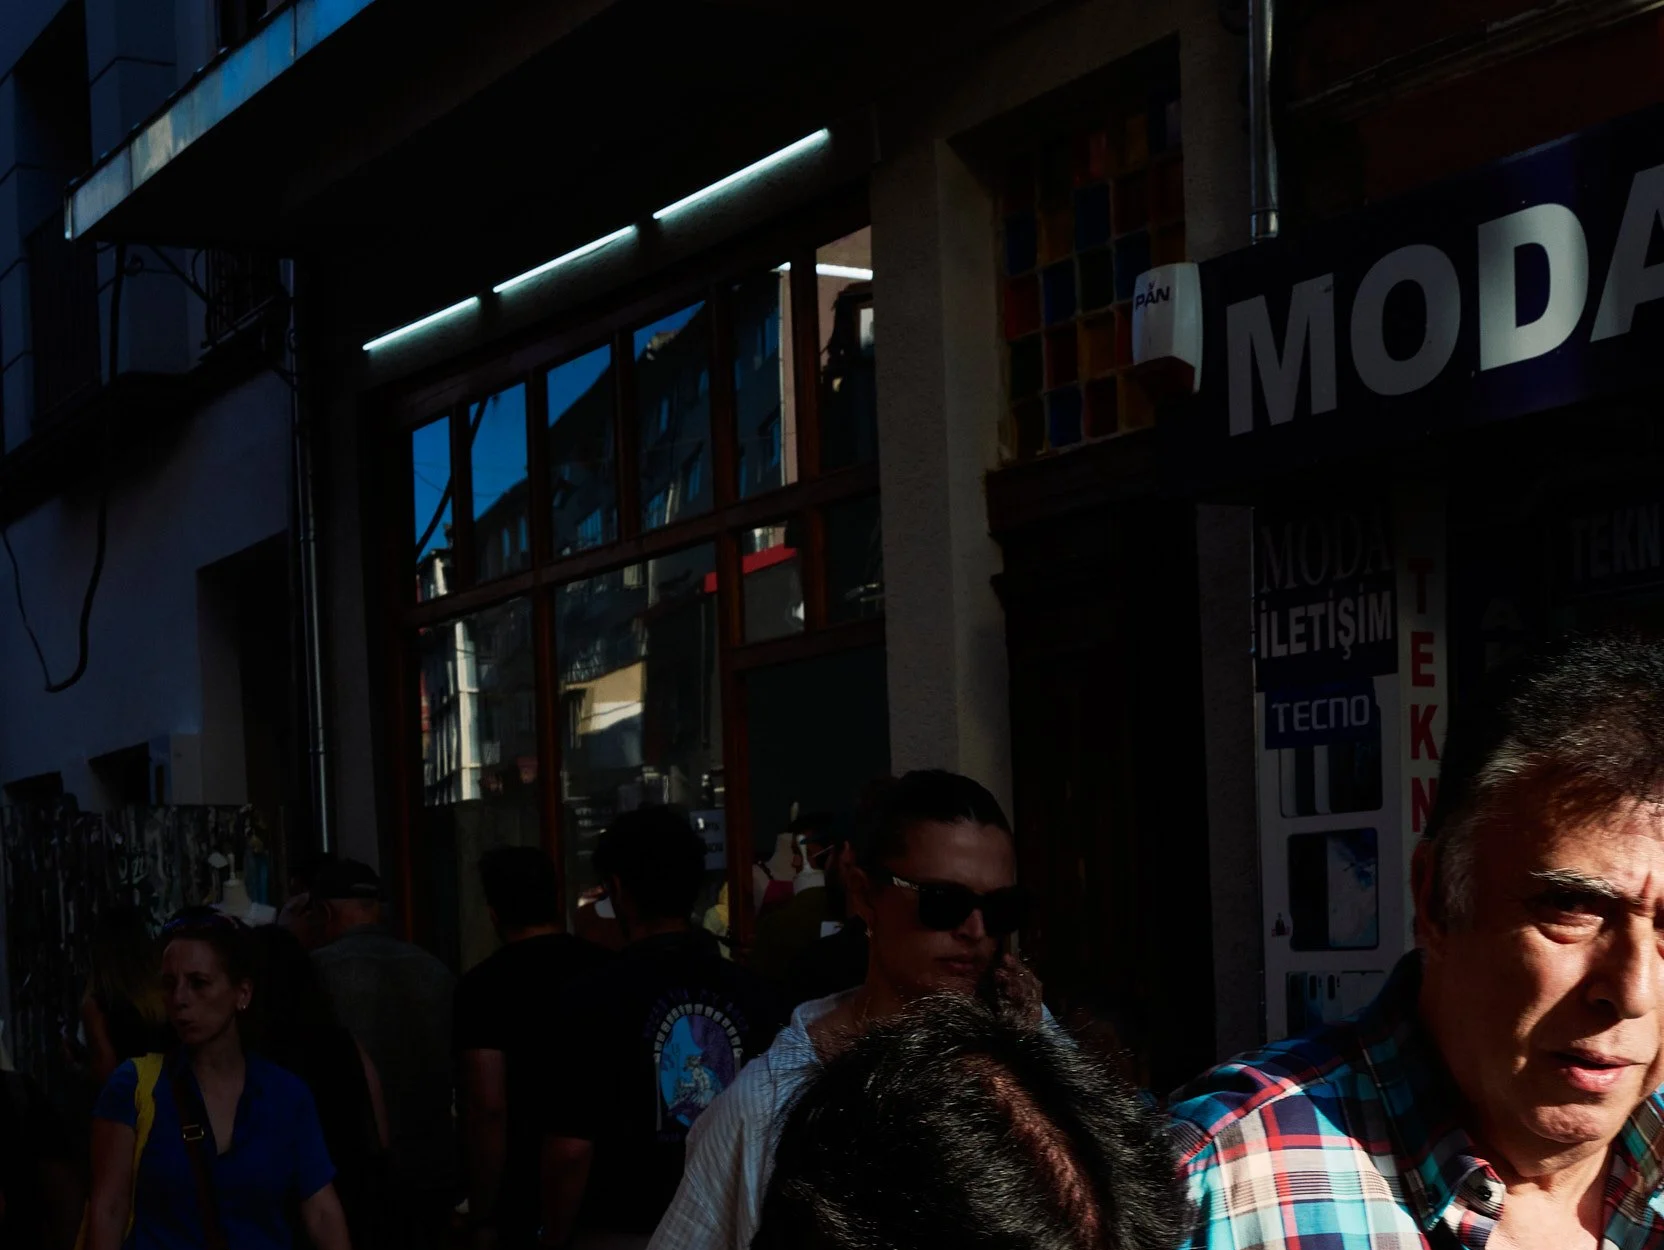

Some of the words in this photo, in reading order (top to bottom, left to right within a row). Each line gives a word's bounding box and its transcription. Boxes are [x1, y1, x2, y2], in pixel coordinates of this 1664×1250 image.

[1260, 504, 1393, 594] MODA
[1259, 582, 1392, 661] İLETİŞİM
[1271, 694, 1370, 733] TECNO
